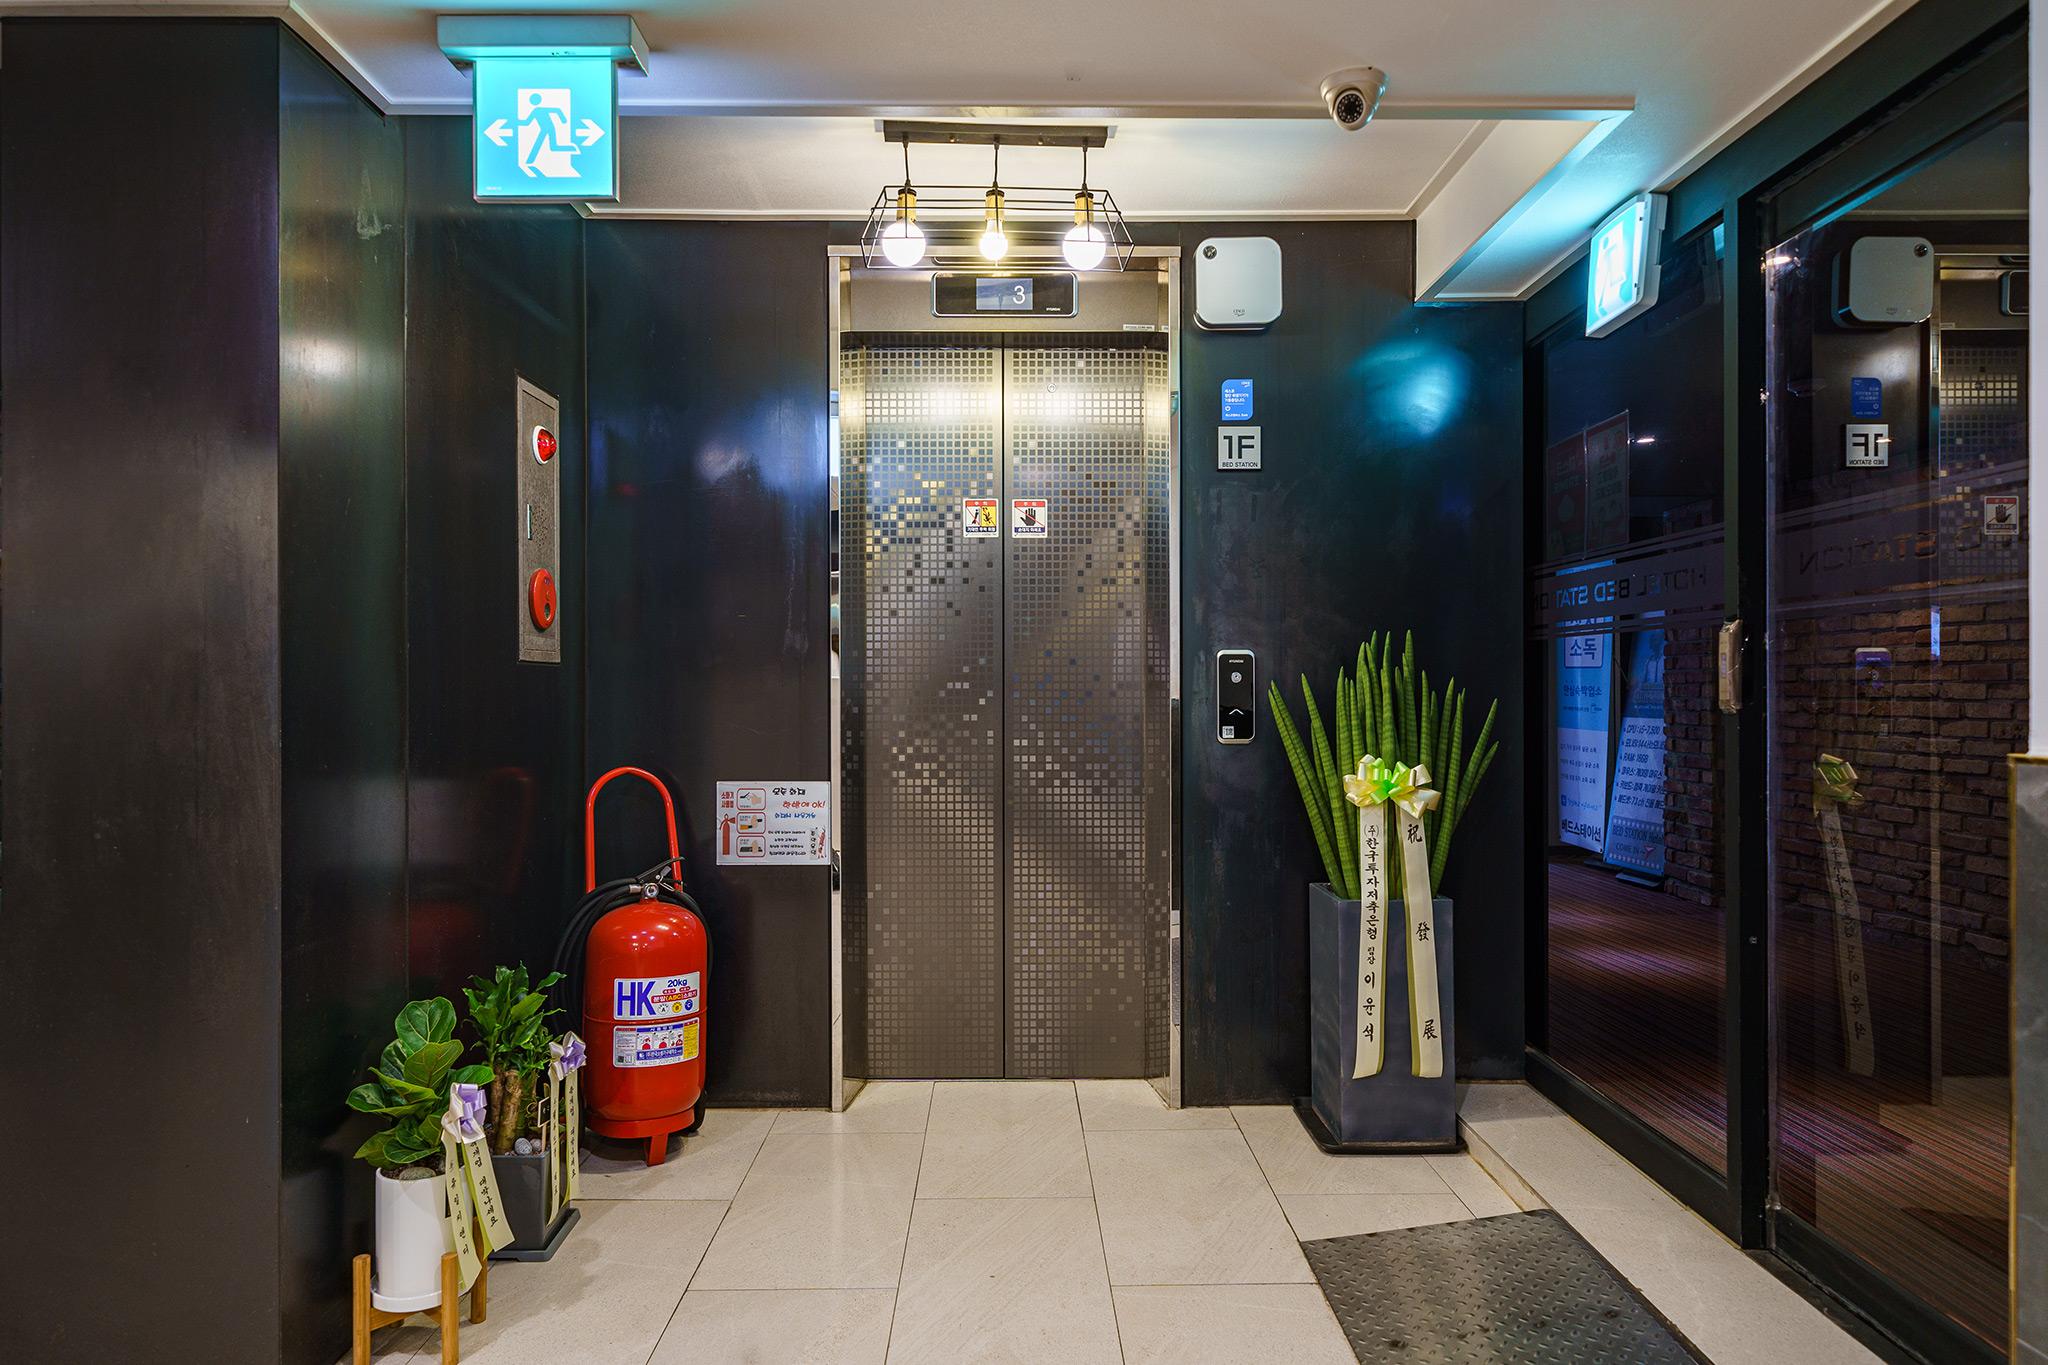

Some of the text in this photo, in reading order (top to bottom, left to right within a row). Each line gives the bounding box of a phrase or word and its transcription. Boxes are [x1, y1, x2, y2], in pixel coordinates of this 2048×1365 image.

[1012, 285, 1026, 304] 3
[1223, 435, 1255, 459] 1F
[1569, 637, 1597, 661] 소독
[1563, 684, 1602, 698] 안심숙박업소
[1561, 818, 1602, 843] 베드스테이션
[667, 978, 688, 988] 20kg
[617, 981, 656, 1017] HK
[1422, 1018, 1438, 1041] 展
